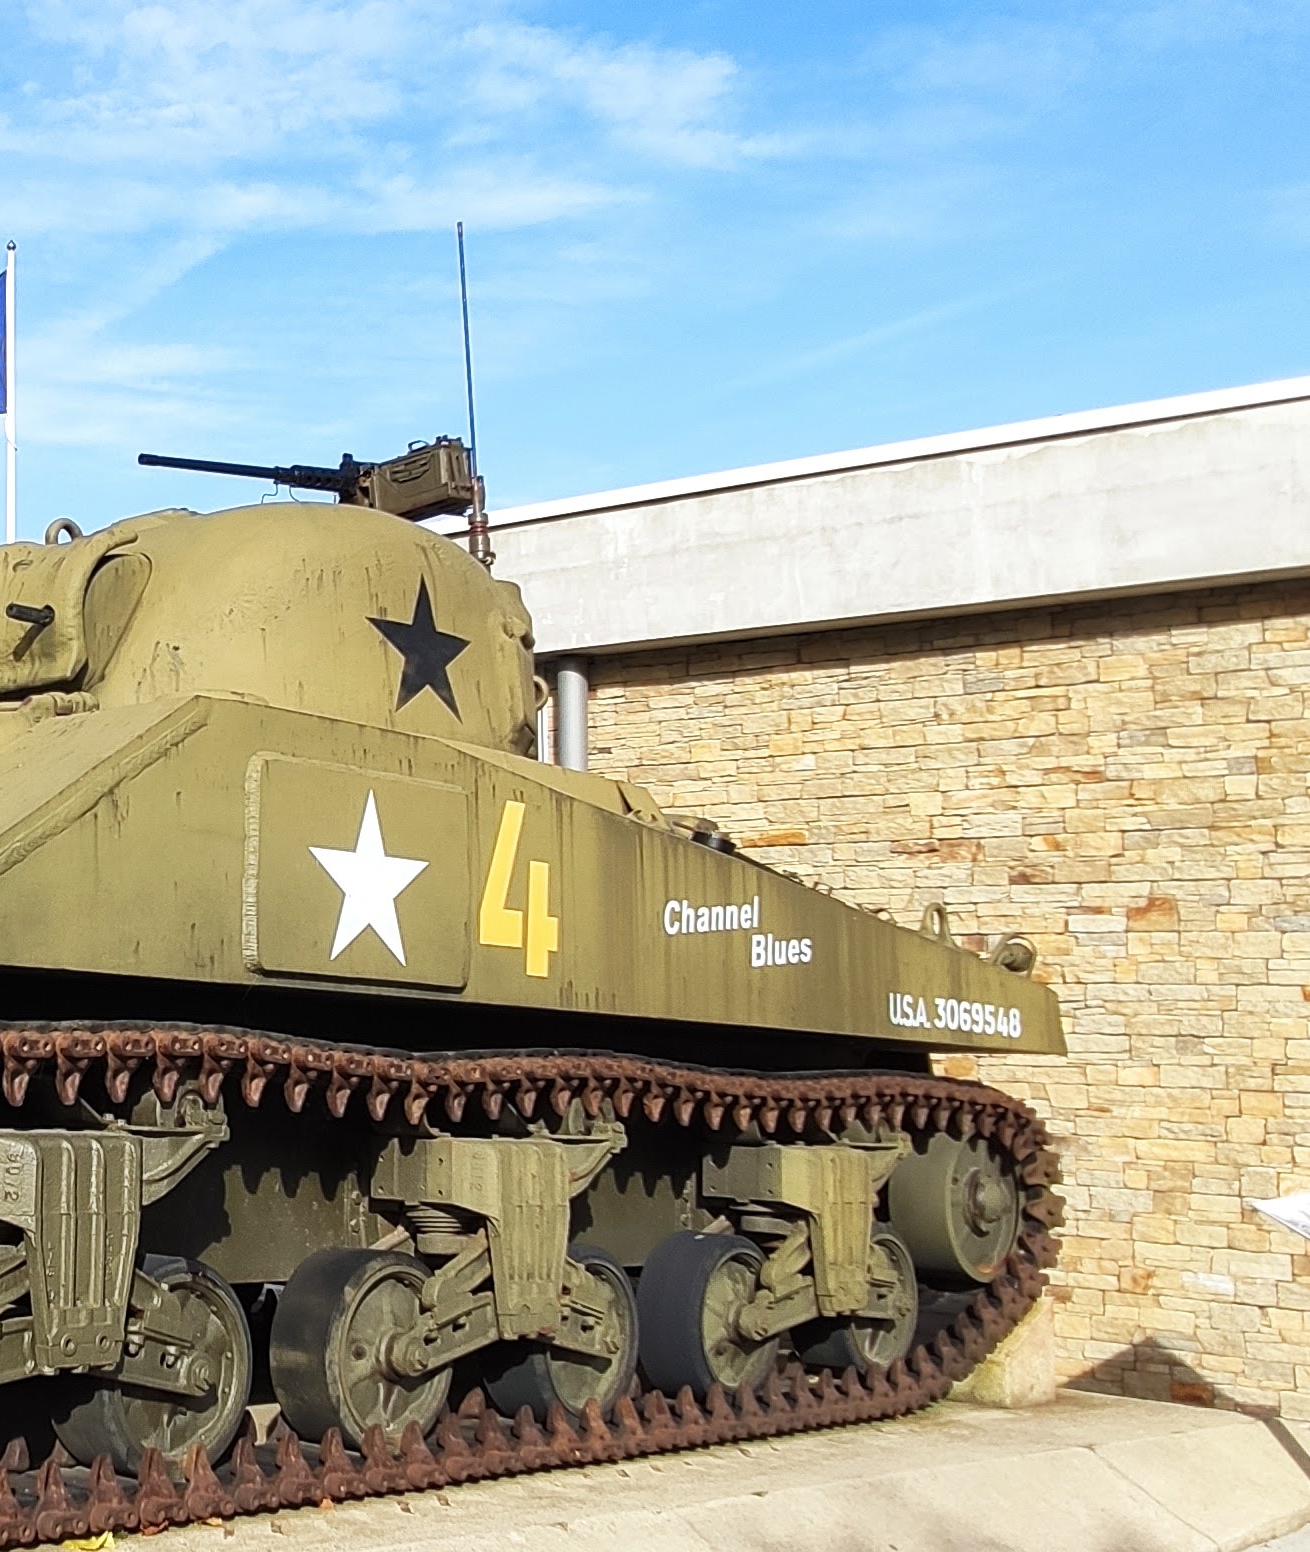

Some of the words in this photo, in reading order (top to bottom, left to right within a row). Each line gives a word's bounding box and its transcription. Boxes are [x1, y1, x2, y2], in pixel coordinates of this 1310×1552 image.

[479, 800, 559, 978] 4
[664, 895, 760, 935] Channel
[751, 933, 812, 968] Blues
[933, 997, 1022, 1038] 3069548
